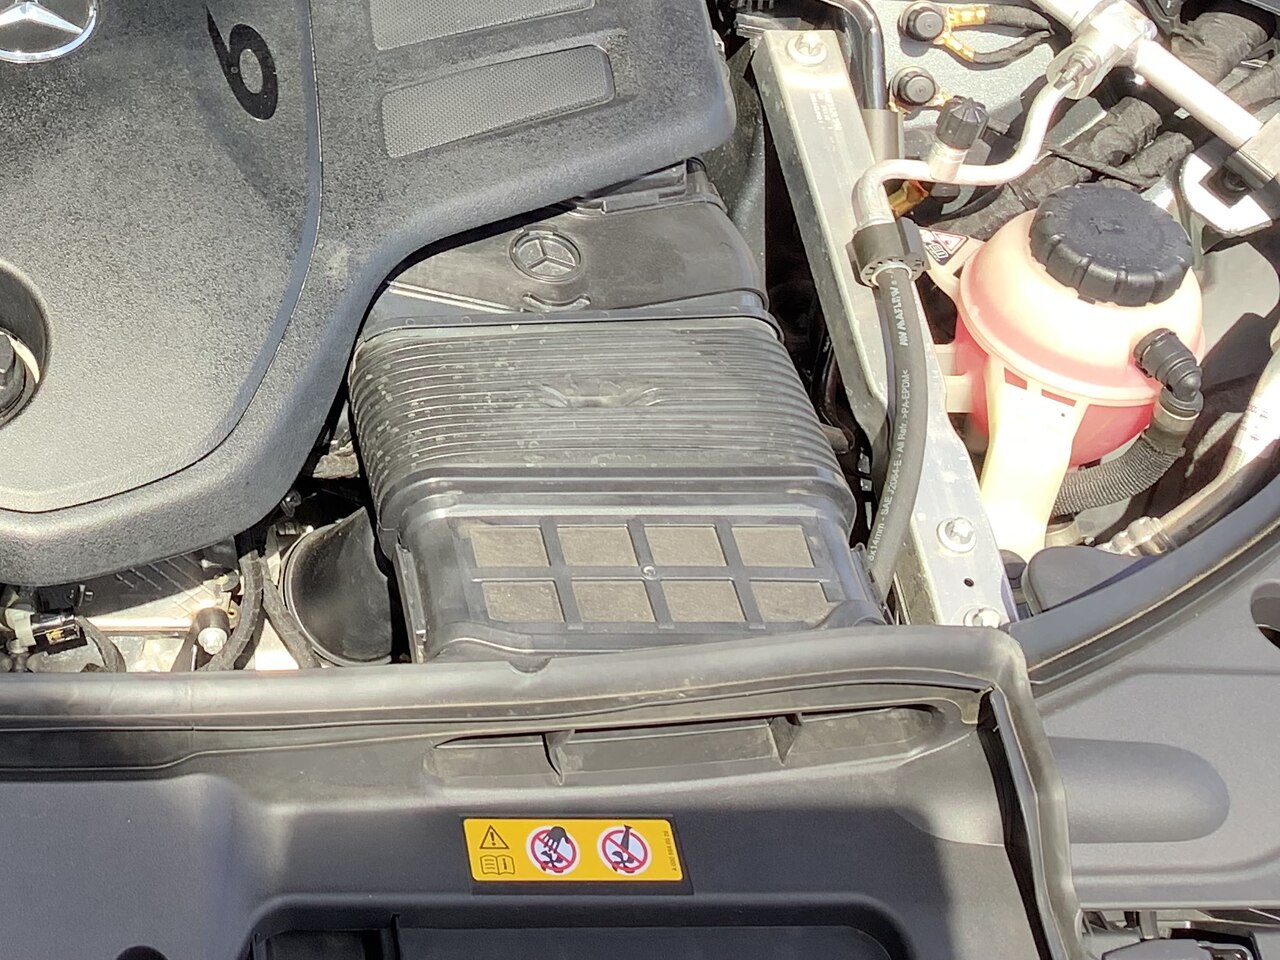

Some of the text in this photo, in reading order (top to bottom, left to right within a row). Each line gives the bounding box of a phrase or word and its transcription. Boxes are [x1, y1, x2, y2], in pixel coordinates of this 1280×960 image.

[205, 4, 279, 121] 6
[880, 496, 893, 516] SAE
[896, 441, 905, 453] All
